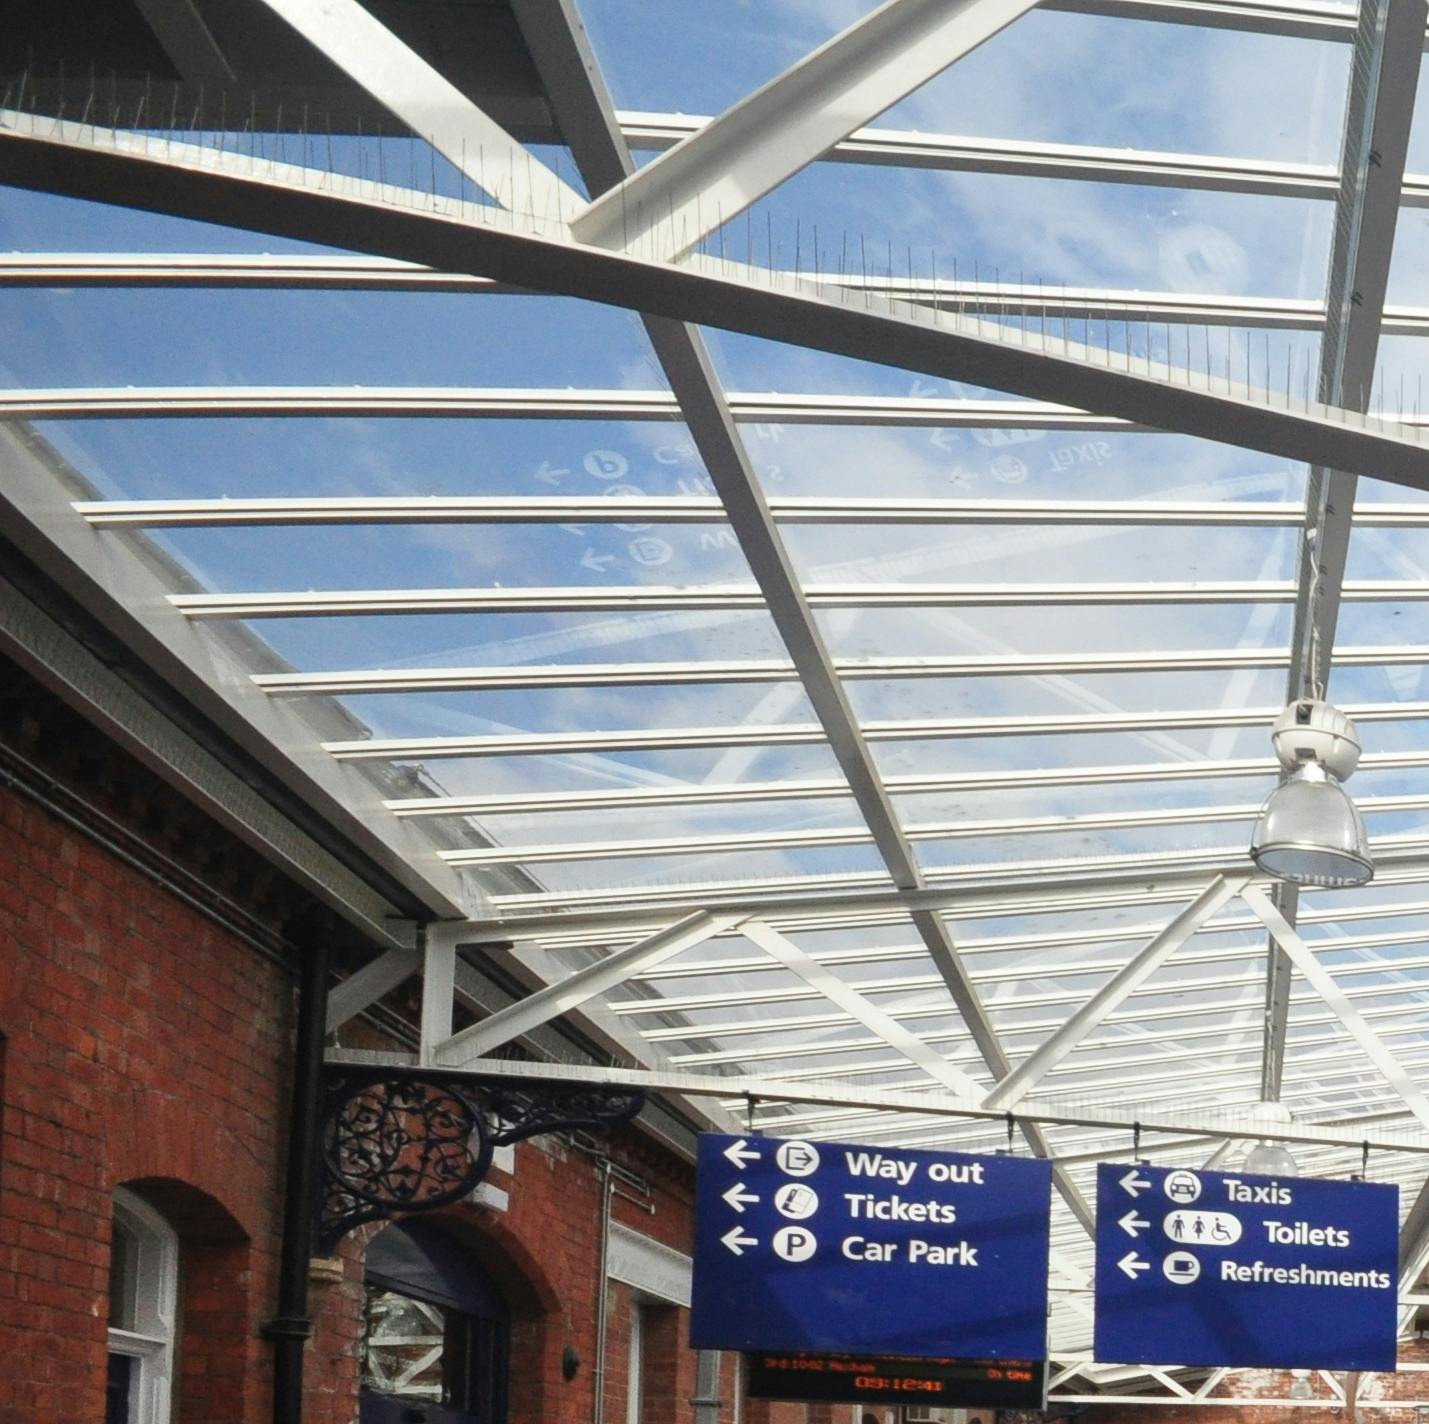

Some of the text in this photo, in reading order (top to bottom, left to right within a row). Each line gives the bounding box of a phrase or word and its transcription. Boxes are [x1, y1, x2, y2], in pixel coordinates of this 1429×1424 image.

[845, 1151, 985, 1185] Way out
[1222, 1178, 1292, 1205] Taxis
[845, 1194, 956, 1224] Tickets
[1263, 1221, 1350, 1247] Toilets
[787, 1233, 978, 1266] P Car Park
[1221, 1261, 1390, 1289] Refreshments
[854, 1376, 943, 1391] 09:12:41
[1006, 1369, 1032, 1381] time
